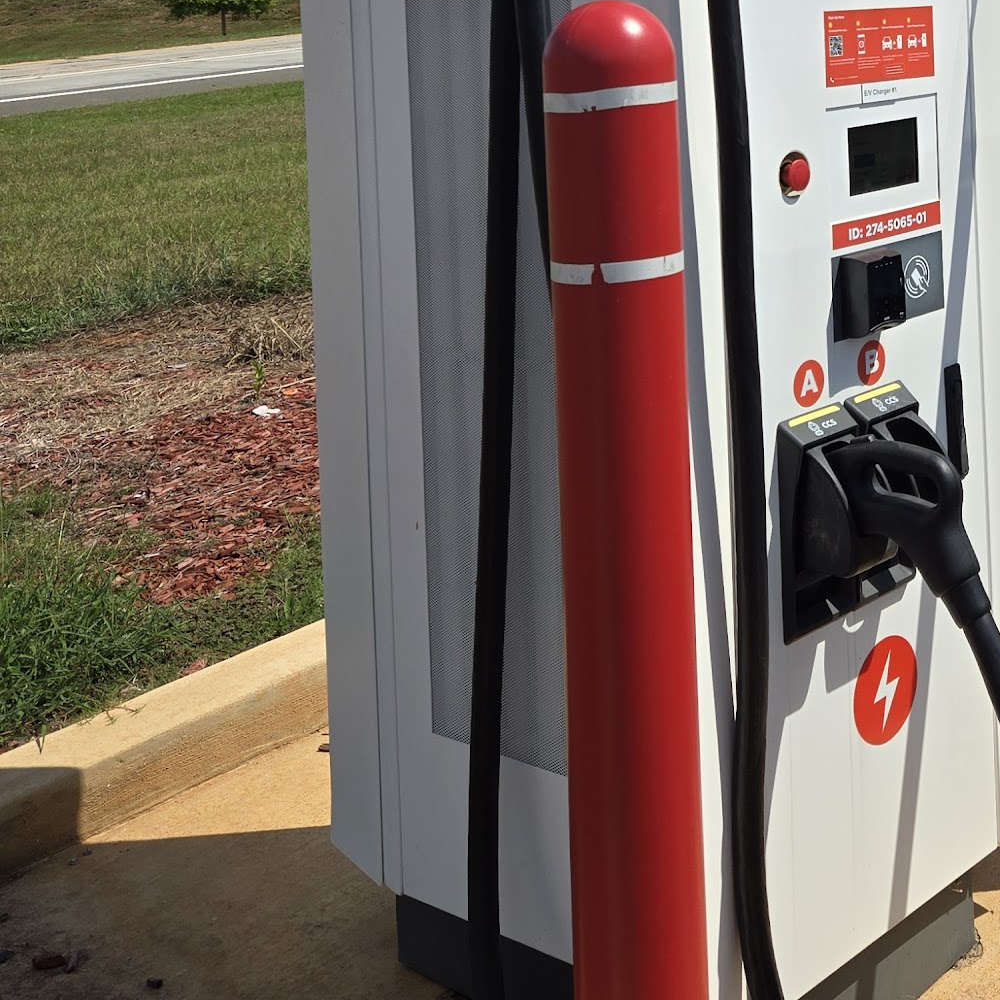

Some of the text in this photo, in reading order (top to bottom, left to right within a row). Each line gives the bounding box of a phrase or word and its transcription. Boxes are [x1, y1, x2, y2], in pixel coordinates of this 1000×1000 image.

[873, 87, 891, 97] Charger
[848, 211, 927, 241] ID: 274-5065-01
[864, 349, 879, 376] B
[800, 369, 818, 398] A
[884, 395, 900, 406] CCS
[821, 418, 837, 429] CCS
